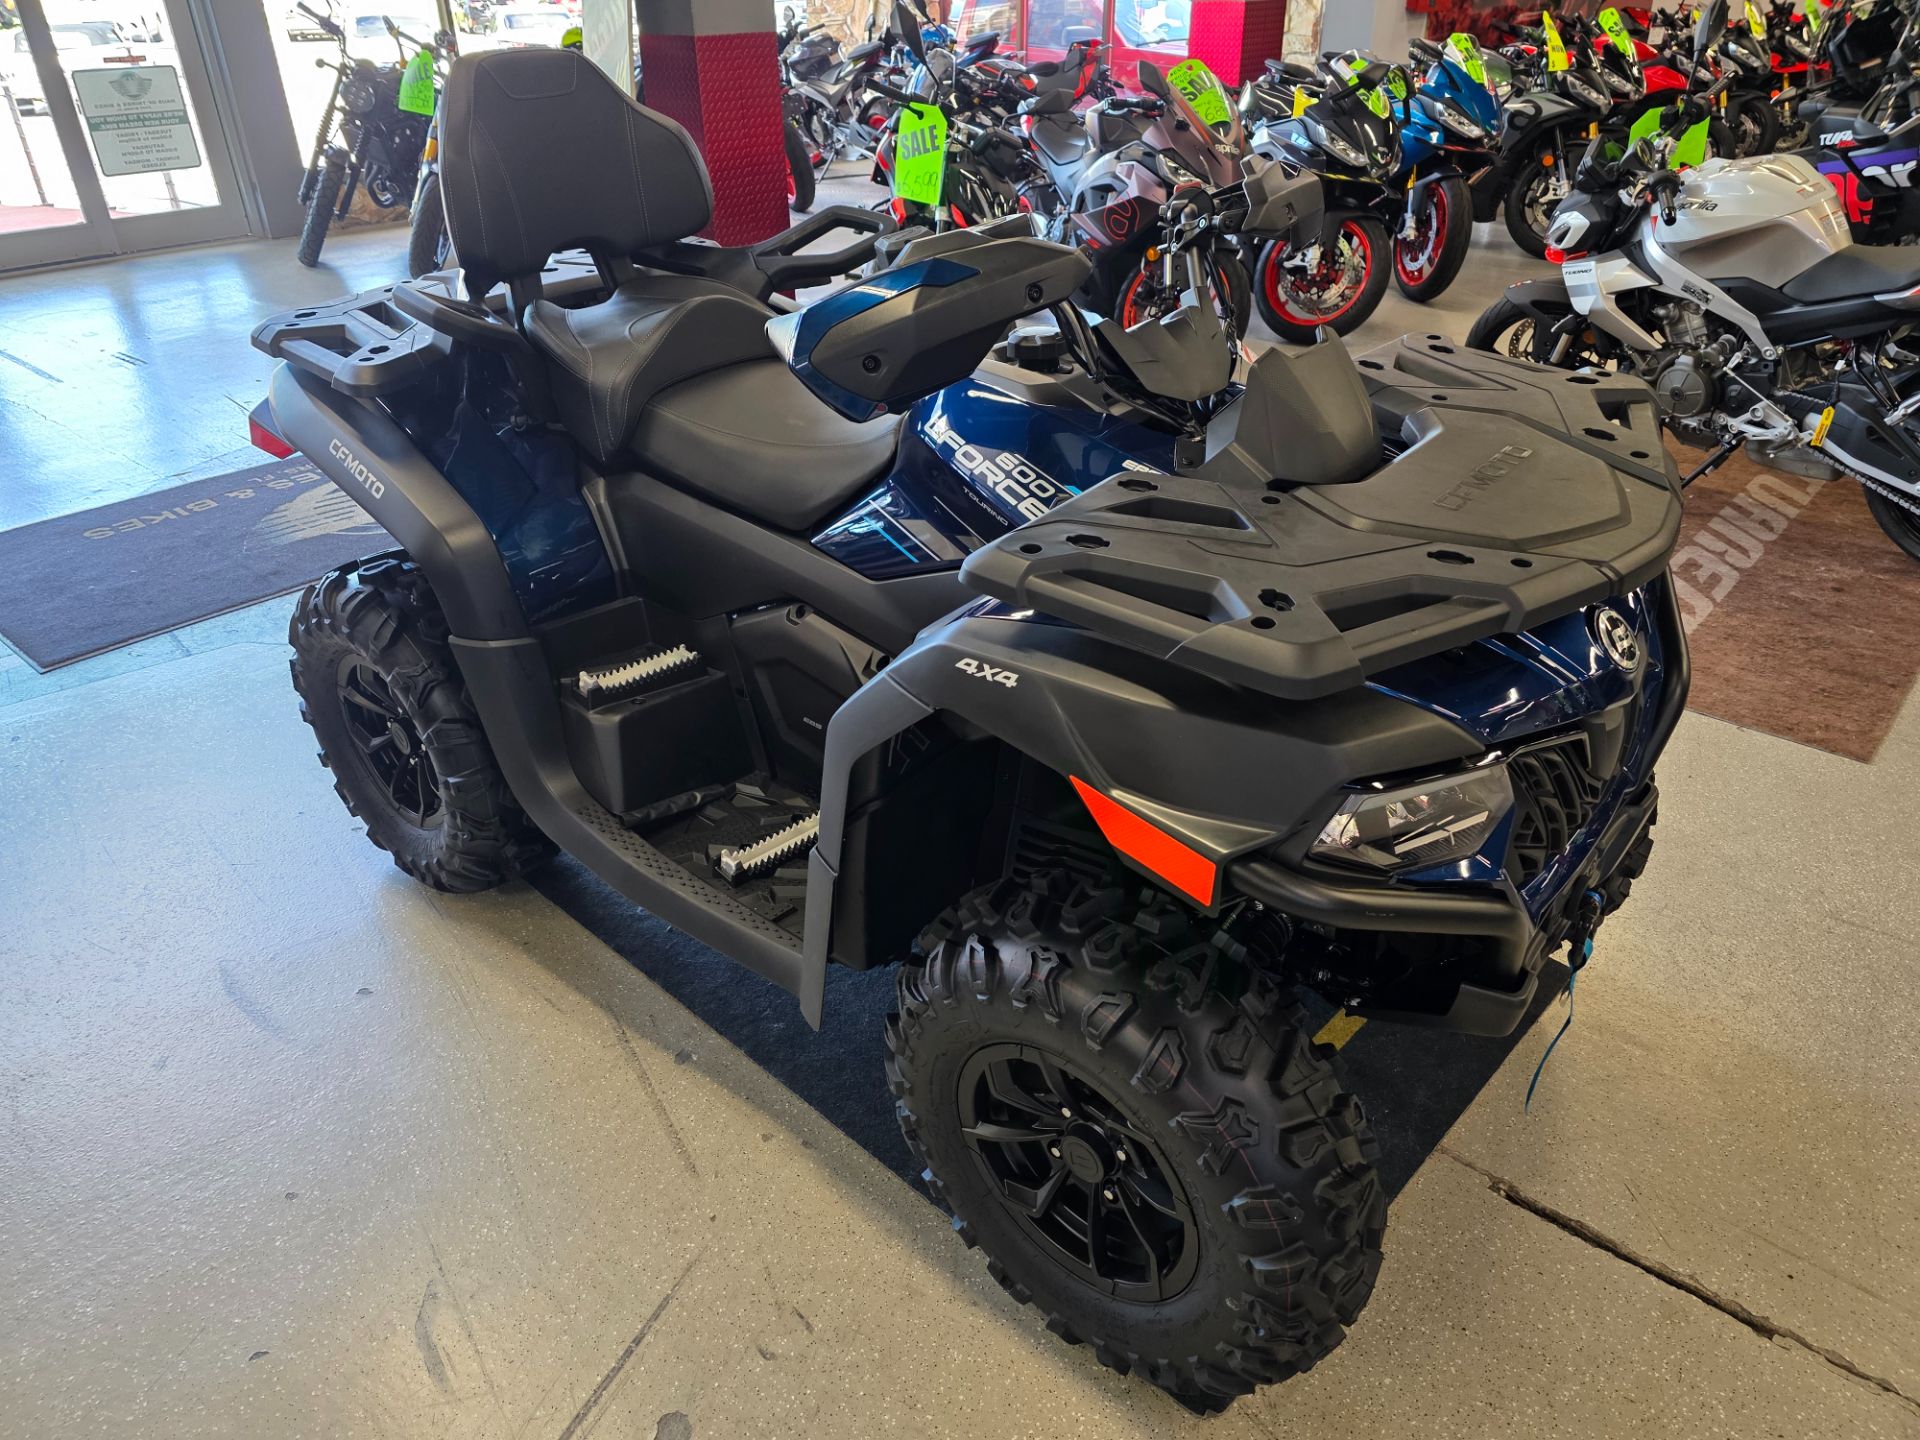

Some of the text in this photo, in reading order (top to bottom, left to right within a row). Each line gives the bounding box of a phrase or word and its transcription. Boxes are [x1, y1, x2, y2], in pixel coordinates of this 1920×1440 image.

[901, 124, 940, 160] SALE
[1677, 200, 1718, 211] prilia
[329, 438, 385, 500] CFMOTO
[995, 452, 1056, 498] 600
[1432, 445, 1533, 511] CFMOTO
[82, 499, 221, 540] BIKES
[962, 485, 1009, 527] TOURING
